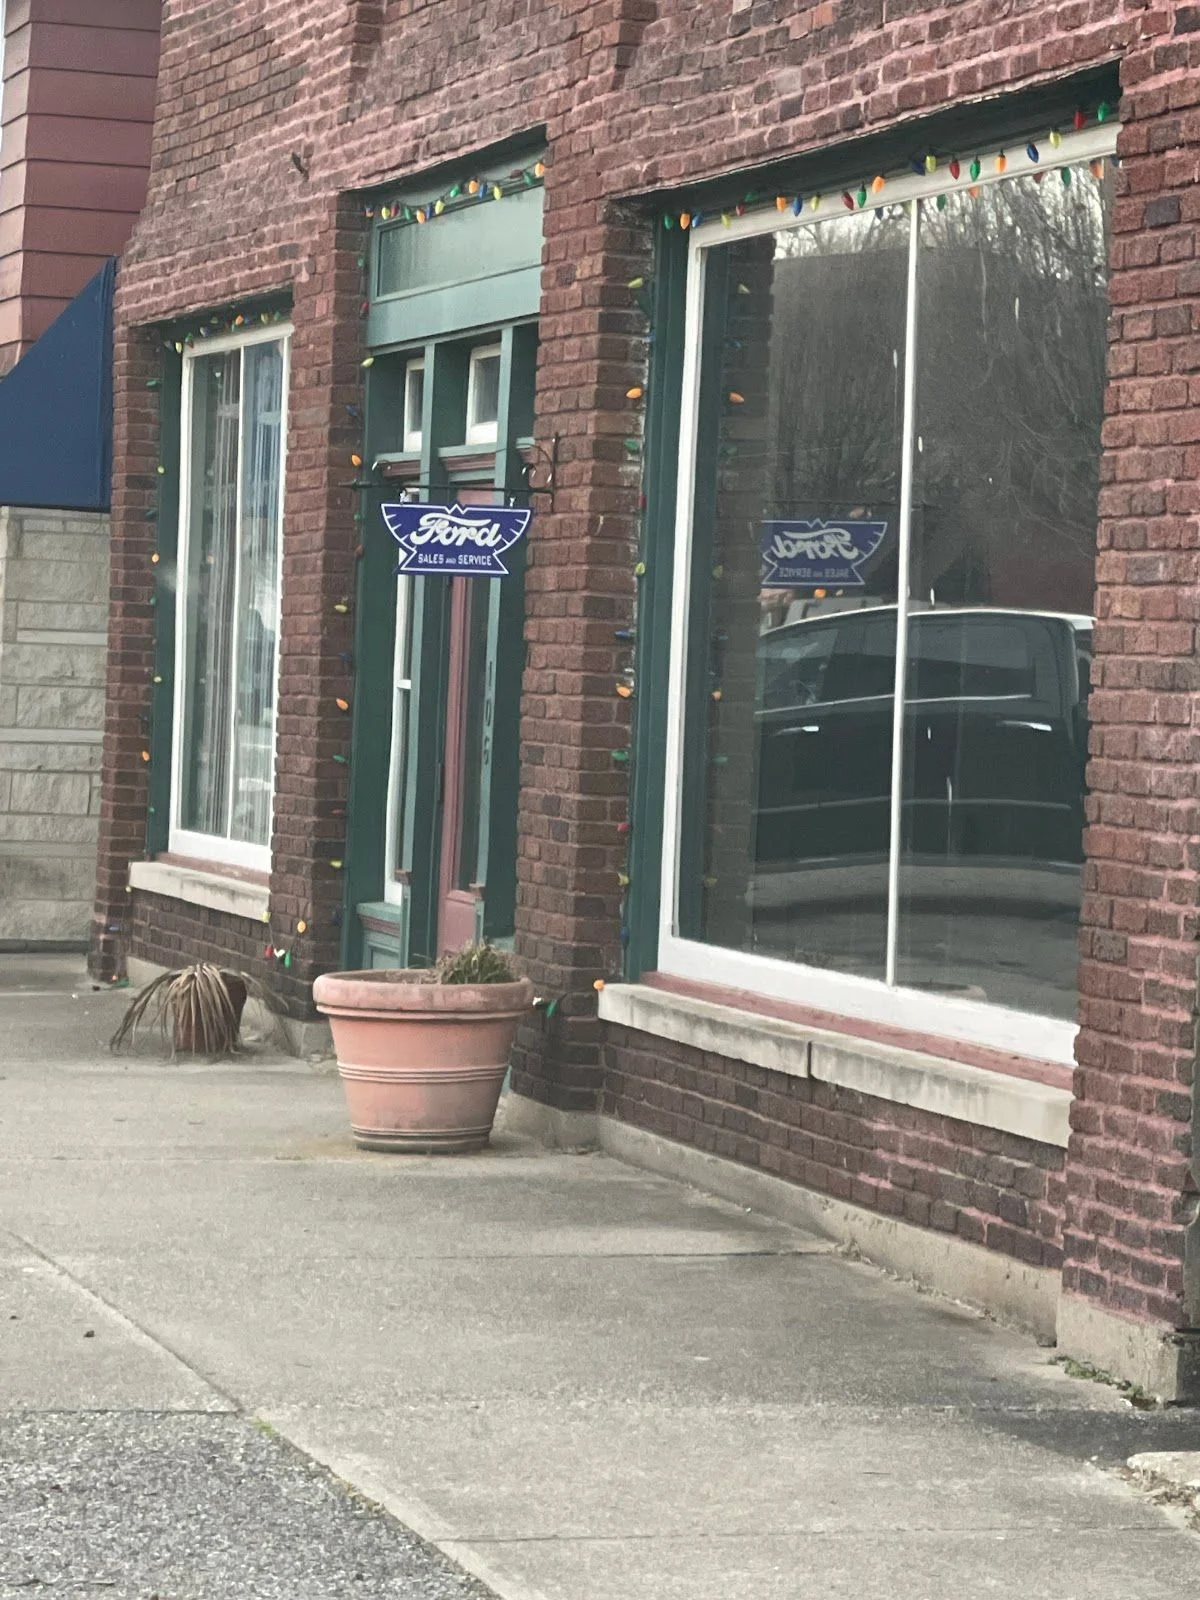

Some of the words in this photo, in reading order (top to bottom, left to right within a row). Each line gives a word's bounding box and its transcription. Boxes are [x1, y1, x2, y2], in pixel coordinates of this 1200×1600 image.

[410, 512, 502, 547] Ford
[418, 553, 444, 564] SALES
[457, 555, 492, 566] SERVICE
